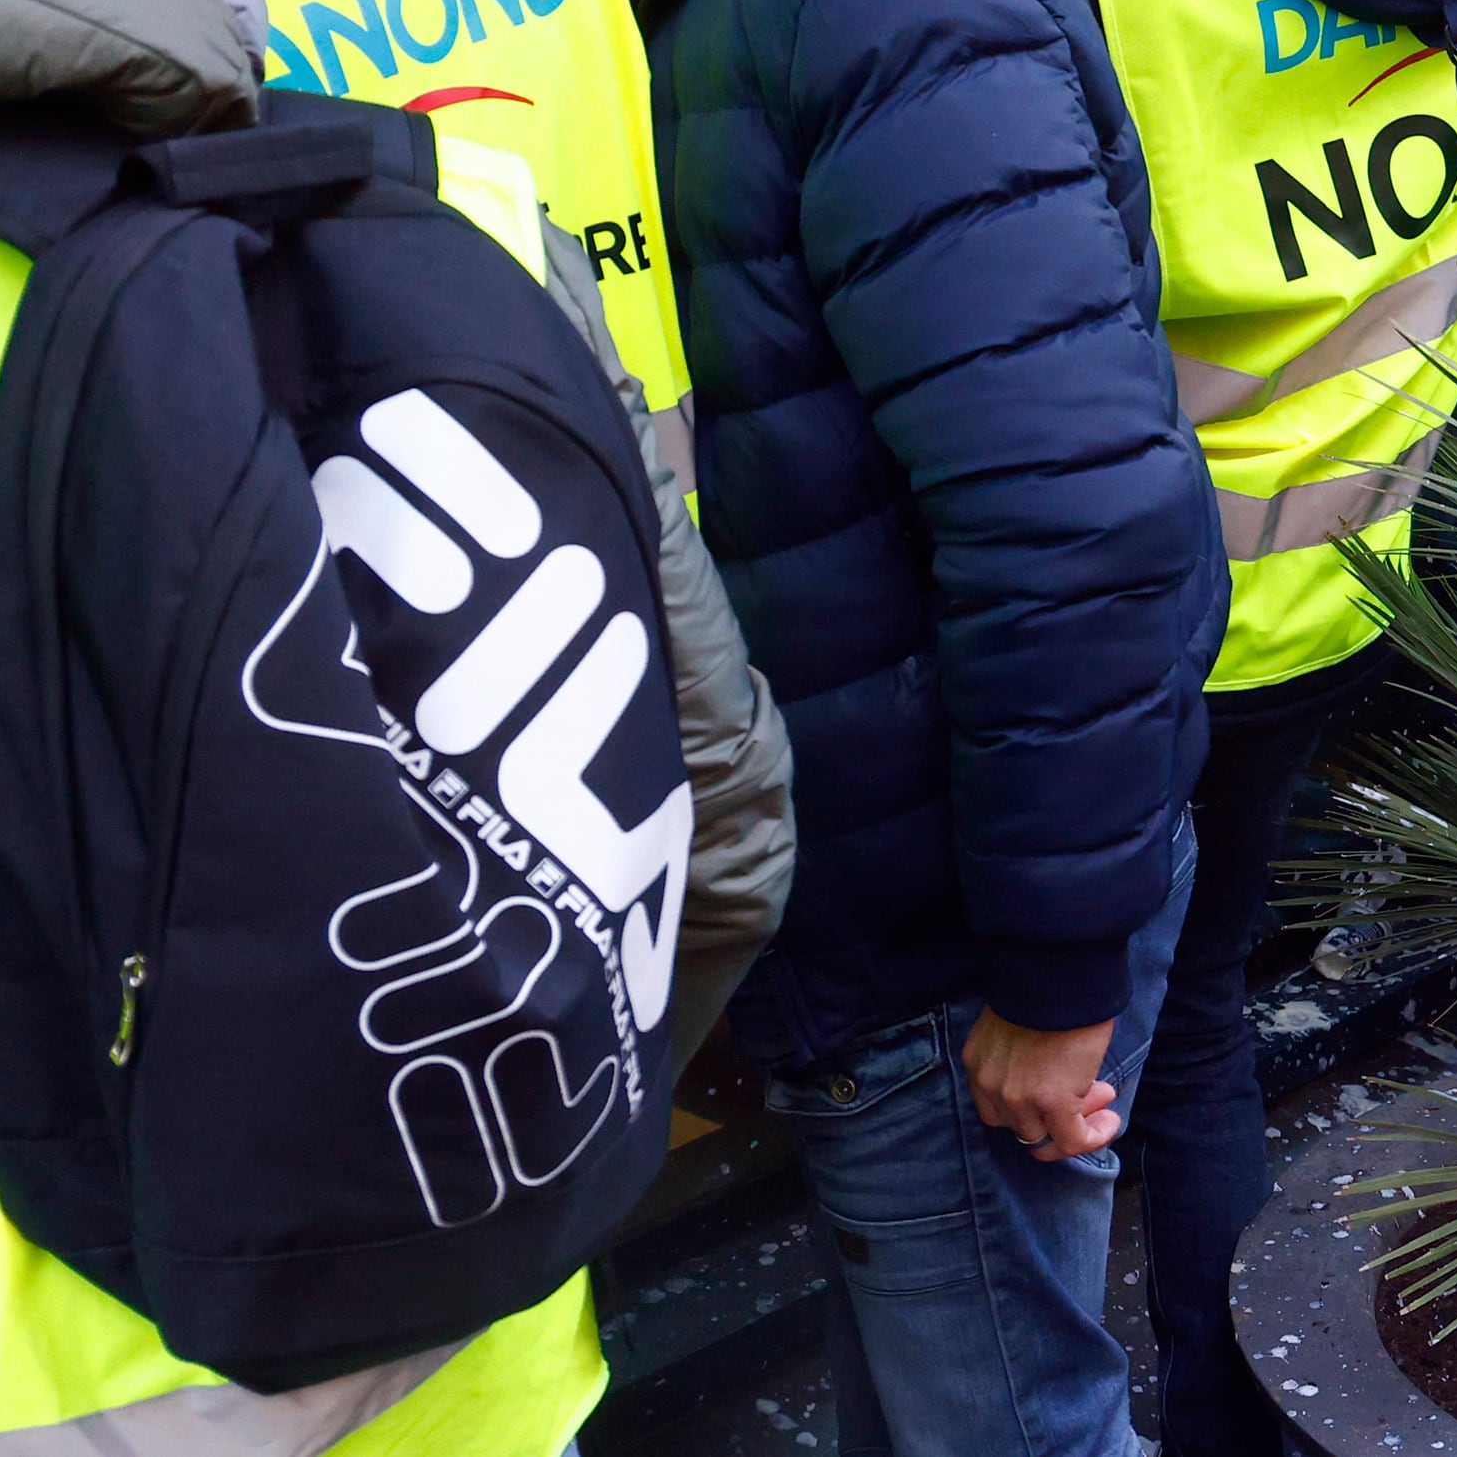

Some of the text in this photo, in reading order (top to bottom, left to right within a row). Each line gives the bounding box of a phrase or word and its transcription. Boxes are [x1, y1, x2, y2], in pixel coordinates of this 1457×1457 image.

[574, 211, 651, 282] RE
[456, 795, 533, 872] FILA
[554, 883, 615, 960] FILA
